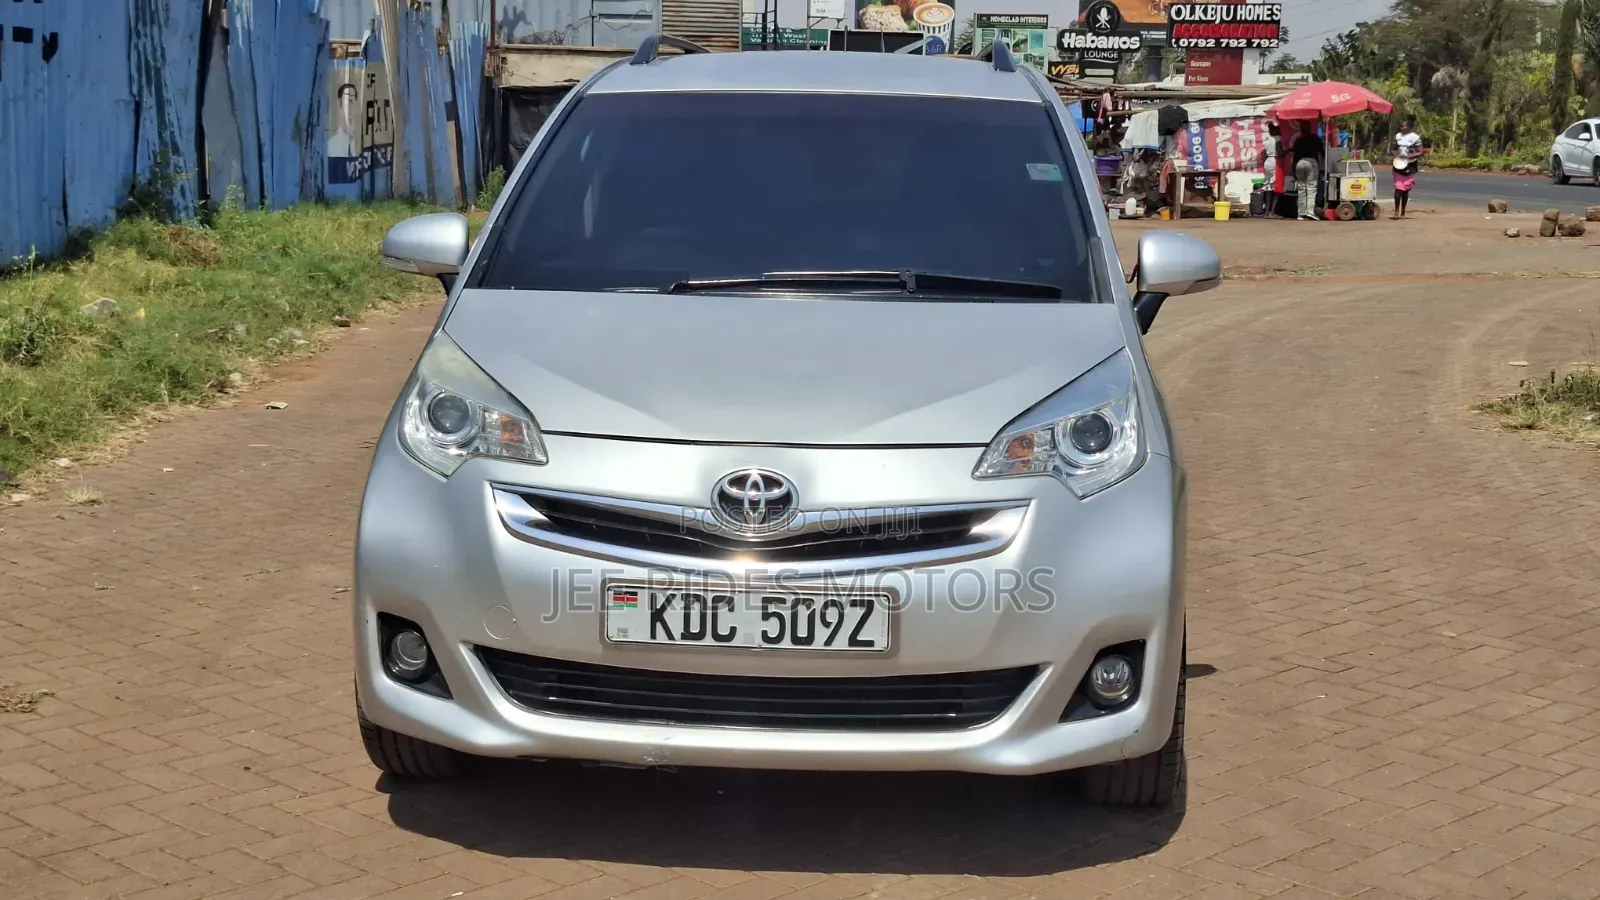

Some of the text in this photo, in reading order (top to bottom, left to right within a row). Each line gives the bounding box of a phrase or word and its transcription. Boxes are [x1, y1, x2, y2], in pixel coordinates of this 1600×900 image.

[990, 15, 1048, 24] HOMECLAD INTERIORS
[1170, 4, 1281, 24] OLKEJU HOMES
[1173, 23, 1278, 38] ACCOMODATION
[1061, 32, 1140, 49] Habanos
[1179, 39, 1279, 48] 0792 792 792
[1084, 50, 1119, 58] LOUNGE
[1331, 93, 1351, 103] 5G
[650, 592, 737, 643] KDC
